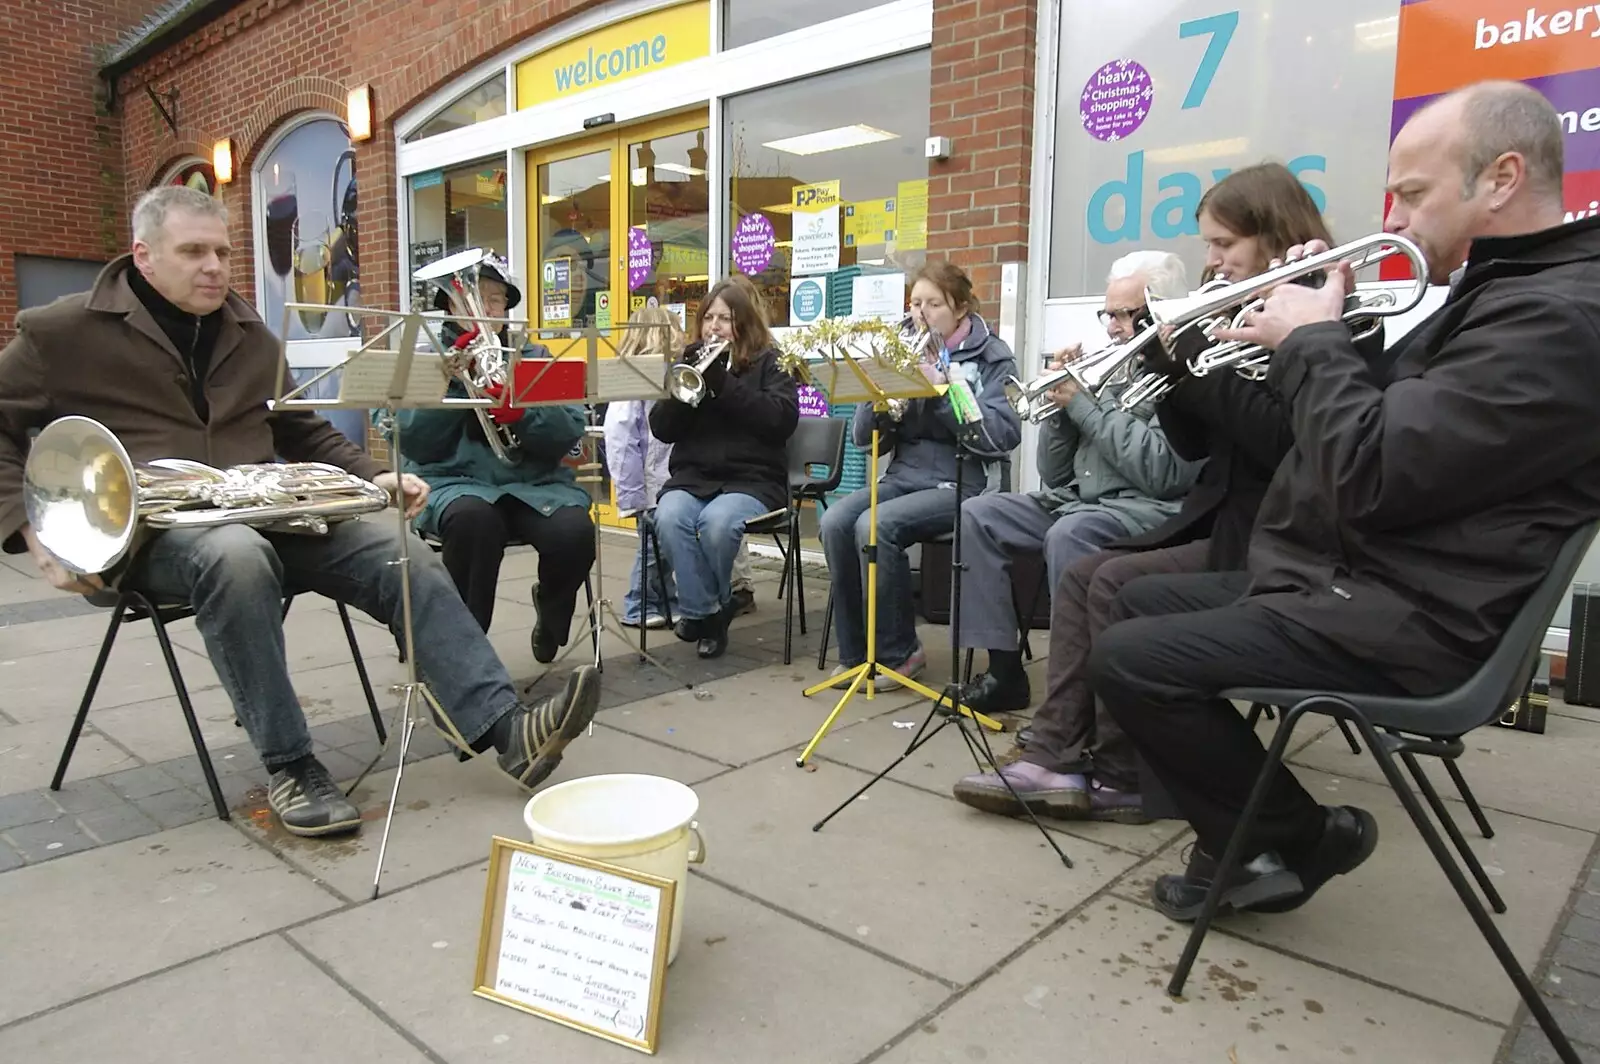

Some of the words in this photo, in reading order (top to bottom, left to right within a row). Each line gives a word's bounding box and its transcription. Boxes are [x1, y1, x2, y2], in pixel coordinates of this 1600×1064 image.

[1475, 4, 1600, 50] bakery
[554, 34, 666, 92] welcome
[1179, 10, 1239, 110] 7
[1097, 68, 1135, 86] heavy
[1091, 84, 1140, 101] Christmas
[1090, 95, 1140, 113] shopping?
[1122, 120, 1133, 128] you
[817, 188, 829, 196] Pay
[1086, 150, 1327, 244] das
[817, 195, 836, 204] Point
[741, 222, 764, 233] heavy
[739, 233, 768, 244] Christmas
[738, 241, 768, 253] shopping?
[629, 256, 652, 268] deals!
[798, 396, 818, 407] eavy
[799, 406, 820, 416] ristmas
